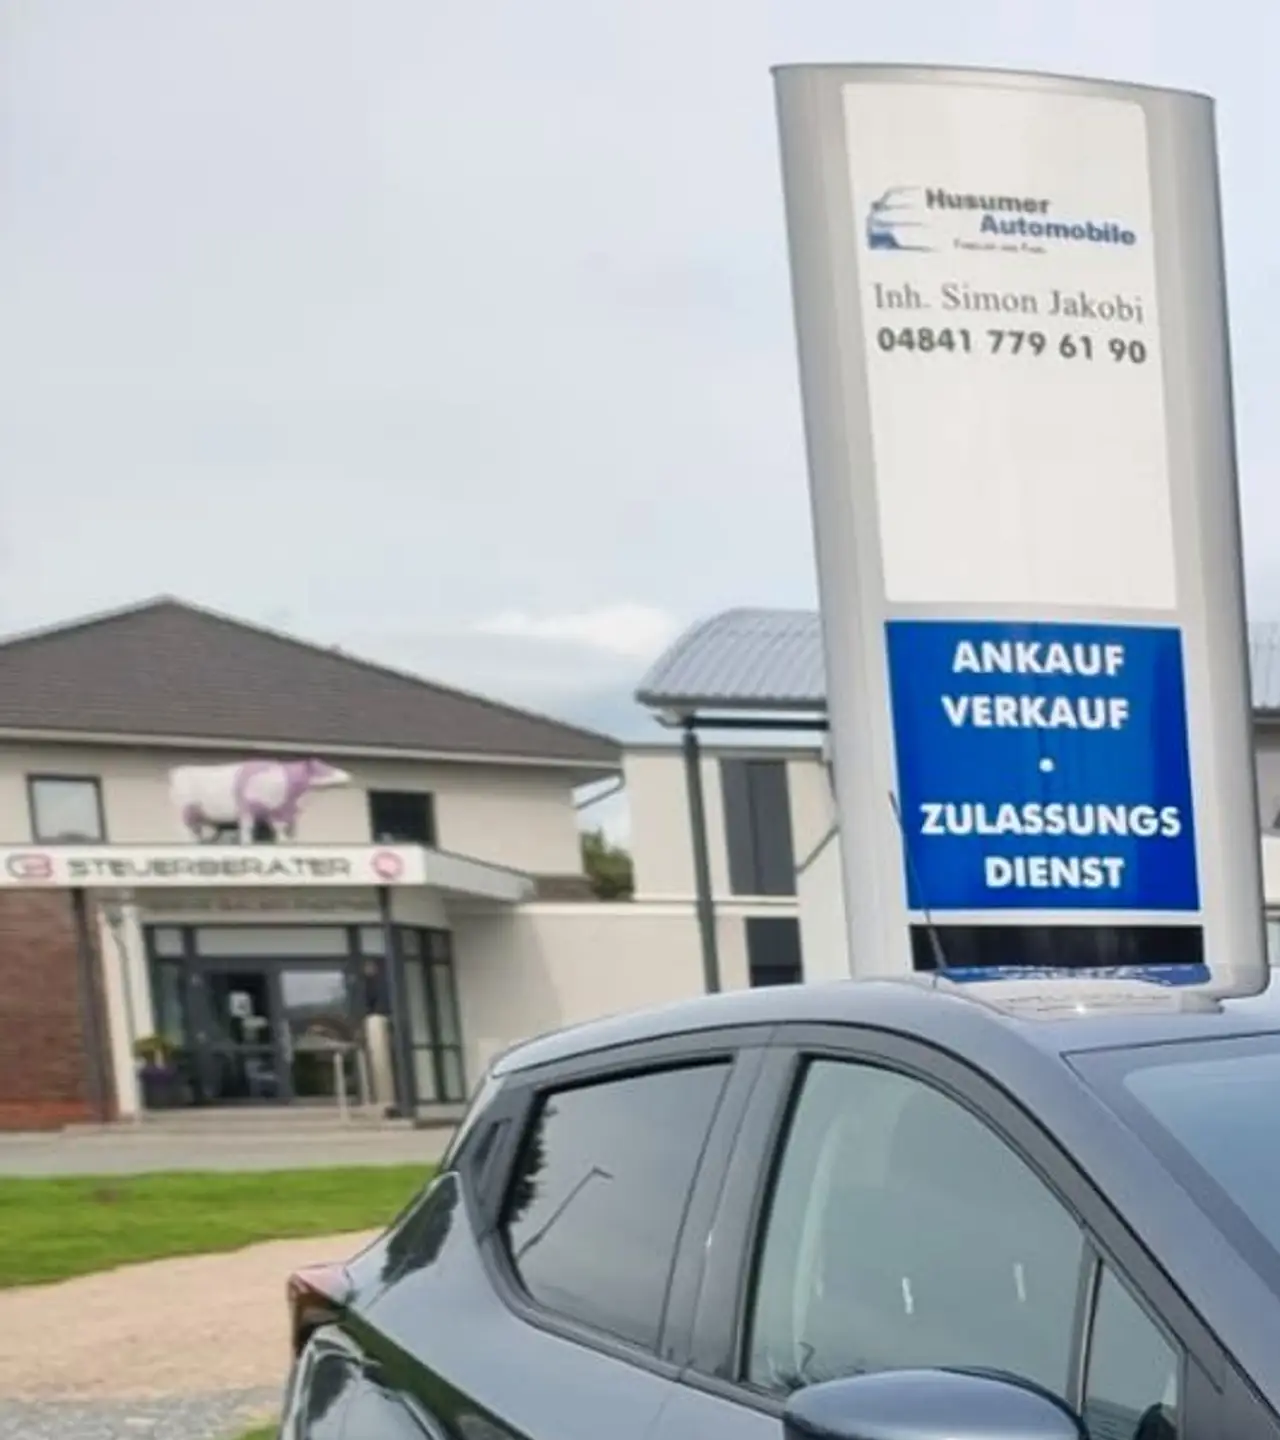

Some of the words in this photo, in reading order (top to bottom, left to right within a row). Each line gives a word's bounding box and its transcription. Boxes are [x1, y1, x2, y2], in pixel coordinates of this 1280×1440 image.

[925, 189, 1051, 214] Husumer
[980, 214, 1137, 246] Automobile
[874, 282, 931, 310] Inh.
[941, 283, 1039, 315] Simon
[1048, 289, 1144, 324] Jakobi
[877, 327, 972, 353] 04841
[987, 329, 1047, 357] 779
[1058, 333, 1093, 361] 61
[1108, 337, 1147, 365] 90
[952, 640, 1126, 676] ANKAUF
[941, 695, 1131, 730] VERKAUF
[919, 803, 1182, 838] ZULASSUNGS
[66, 856, 351, 878] STEUERBERATER
[984, 855, 1126, 889] DIENST
